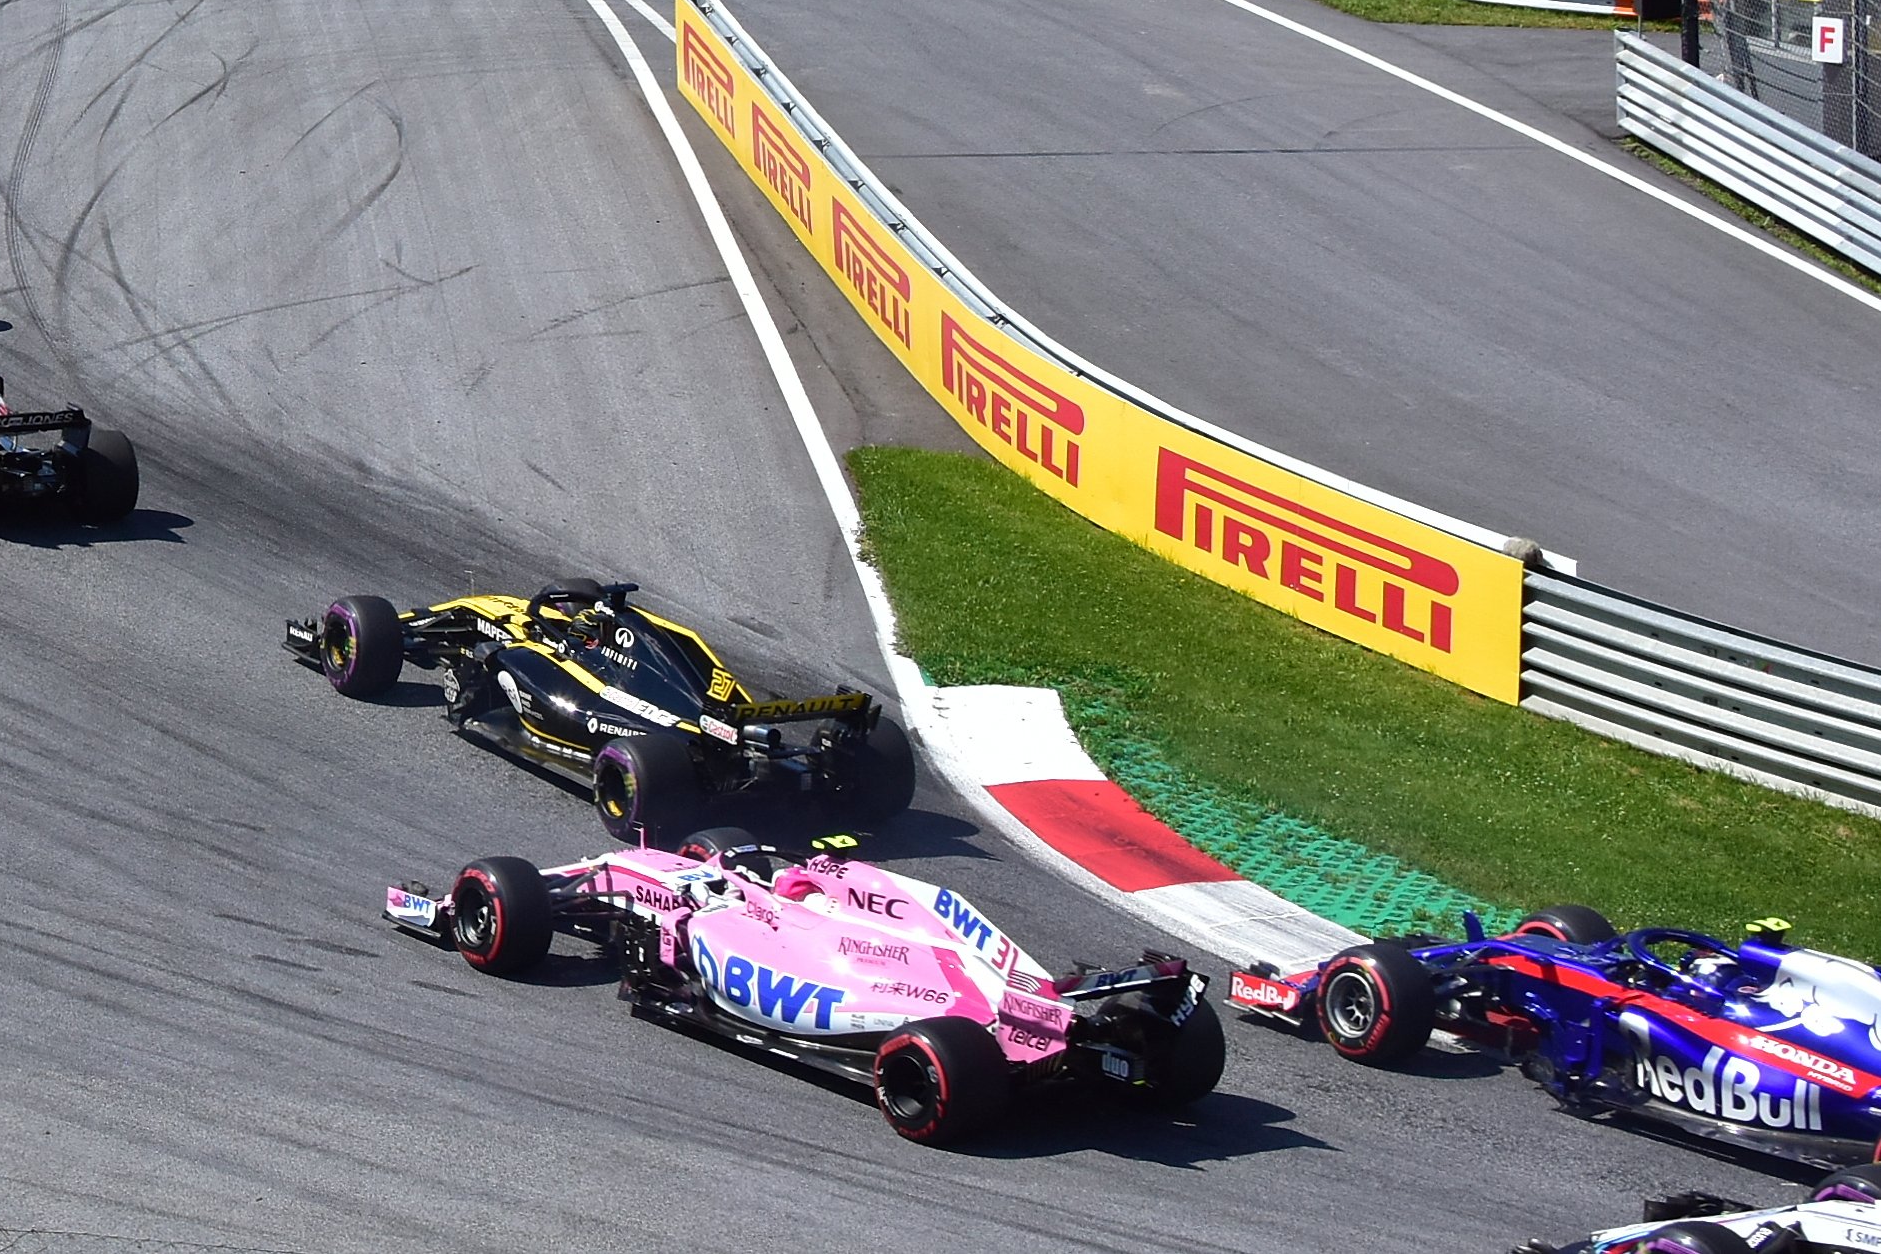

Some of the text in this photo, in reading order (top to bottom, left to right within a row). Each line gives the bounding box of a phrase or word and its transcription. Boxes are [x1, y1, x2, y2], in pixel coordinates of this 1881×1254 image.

[1820, 26, 1835, 53] F
[683, 20, 736, 140] PIRELLI
[751, 100, 814, 236] PIRELLI
[832, 195, 911, 350] PIRELLI
[941, 310, 1086, 489] PIRELLI
[23, 412, 74, 426] JONES
[1155, 447, 1460, 654] PIRELLI
[707, 668, 736, 702] 27
[738, 698, 855, 720] RENAULT
[707, 721, 738, 743] Castrol
[810, 859, 849, 880] HYPE
[403, 895, 431, 915] BWT
[847, 887, 910, 920] NEC
[933, 886, 1019, 977] BWT 31
[837, 936, 910, 966] KINGFISHER
[724, 955, 846, 1031] BWT
[1170, 973, 1206, 1028] HYPE
[1003, 992, 1064, 1030] KINGFISHER
[1008, 1027, 1052, 1052] telcel
[1102, 1052, 1130, 1078] duo
[1749, 1034, 1857, 1085] HONDA
